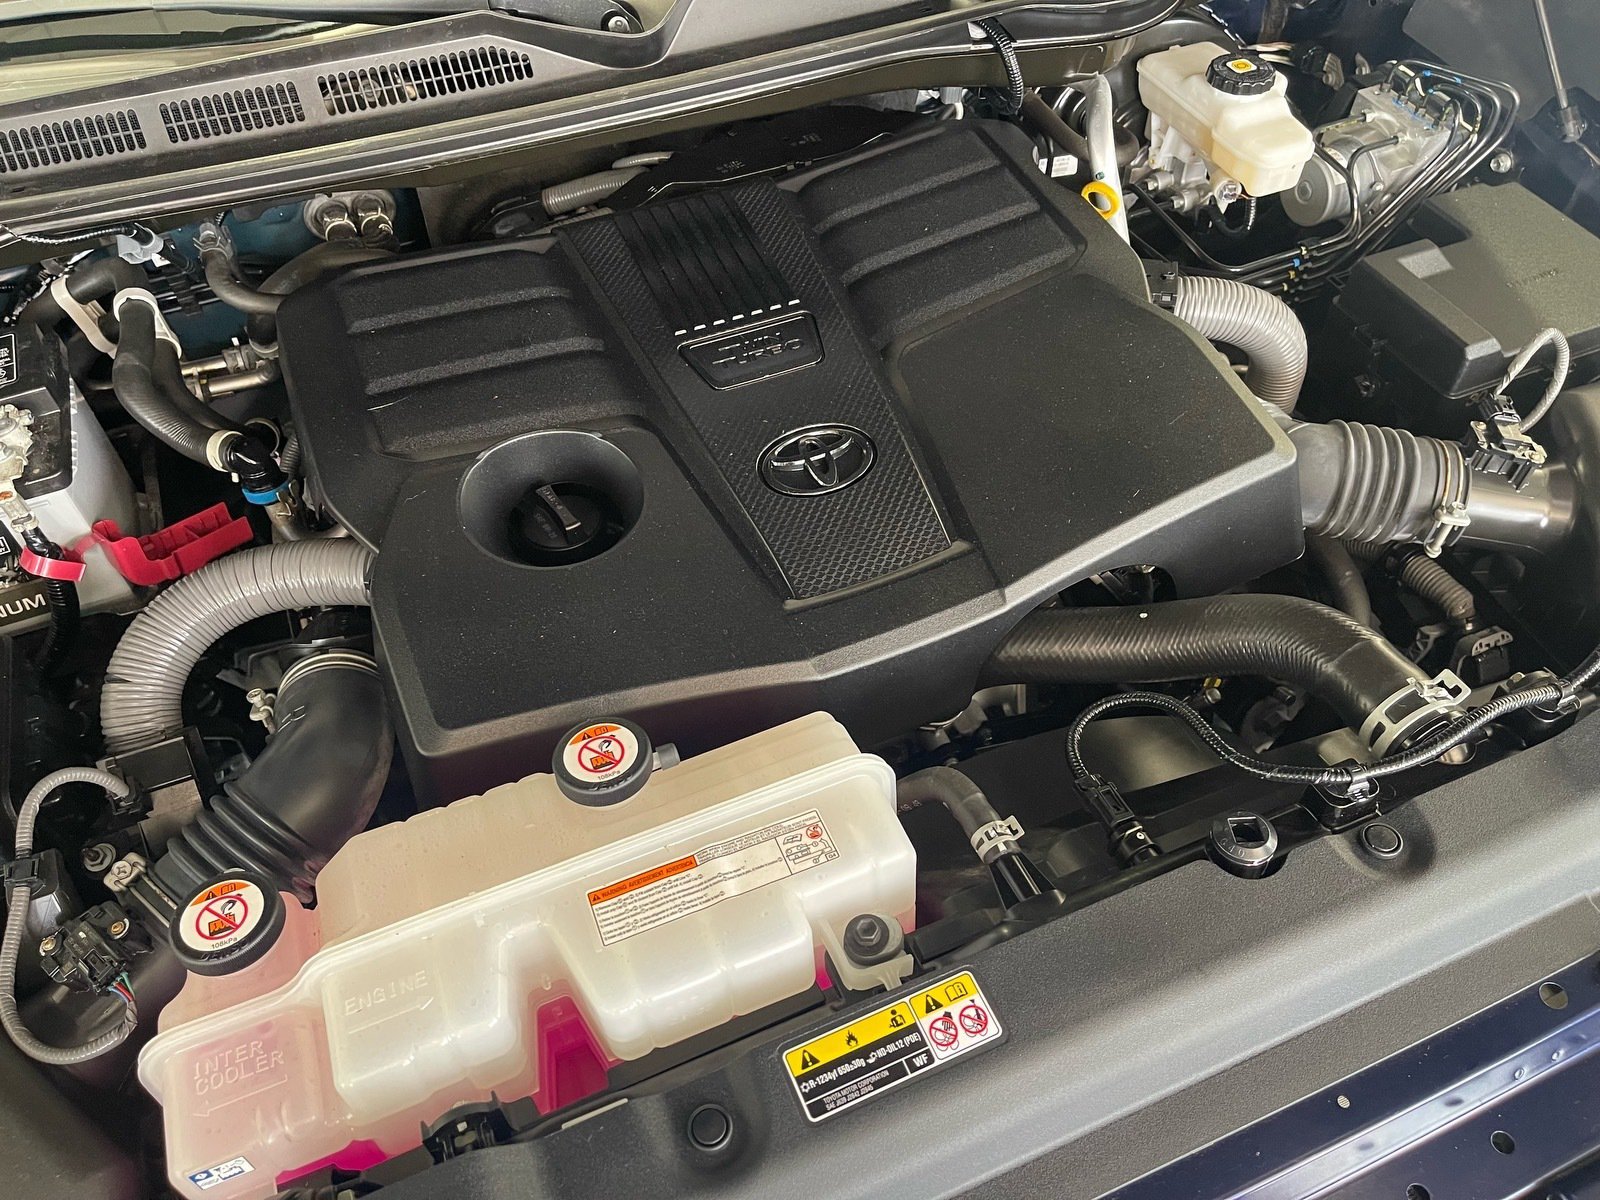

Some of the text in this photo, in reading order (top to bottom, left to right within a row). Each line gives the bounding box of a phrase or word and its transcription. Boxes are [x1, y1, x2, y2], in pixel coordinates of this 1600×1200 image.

[602, 884, 627, 897] WARNING
[211, 937, 238, 949] 108kPa
[344, 970, 428, 1016] ENGINE
[194, 1040, 263, 1079] INTER
[195, 1051, 284, 1095] COOLER
[809, 1069, 839, 1089] R-1234yf
[876, 1040, 904, 1058] ND-OIL12
[903, 1032, 922, 1047] (POE)
[912, 1053, 929, 1068] WF
[823, 1069, 889, 1104] TOYOTA MOTOR CORPORATION
